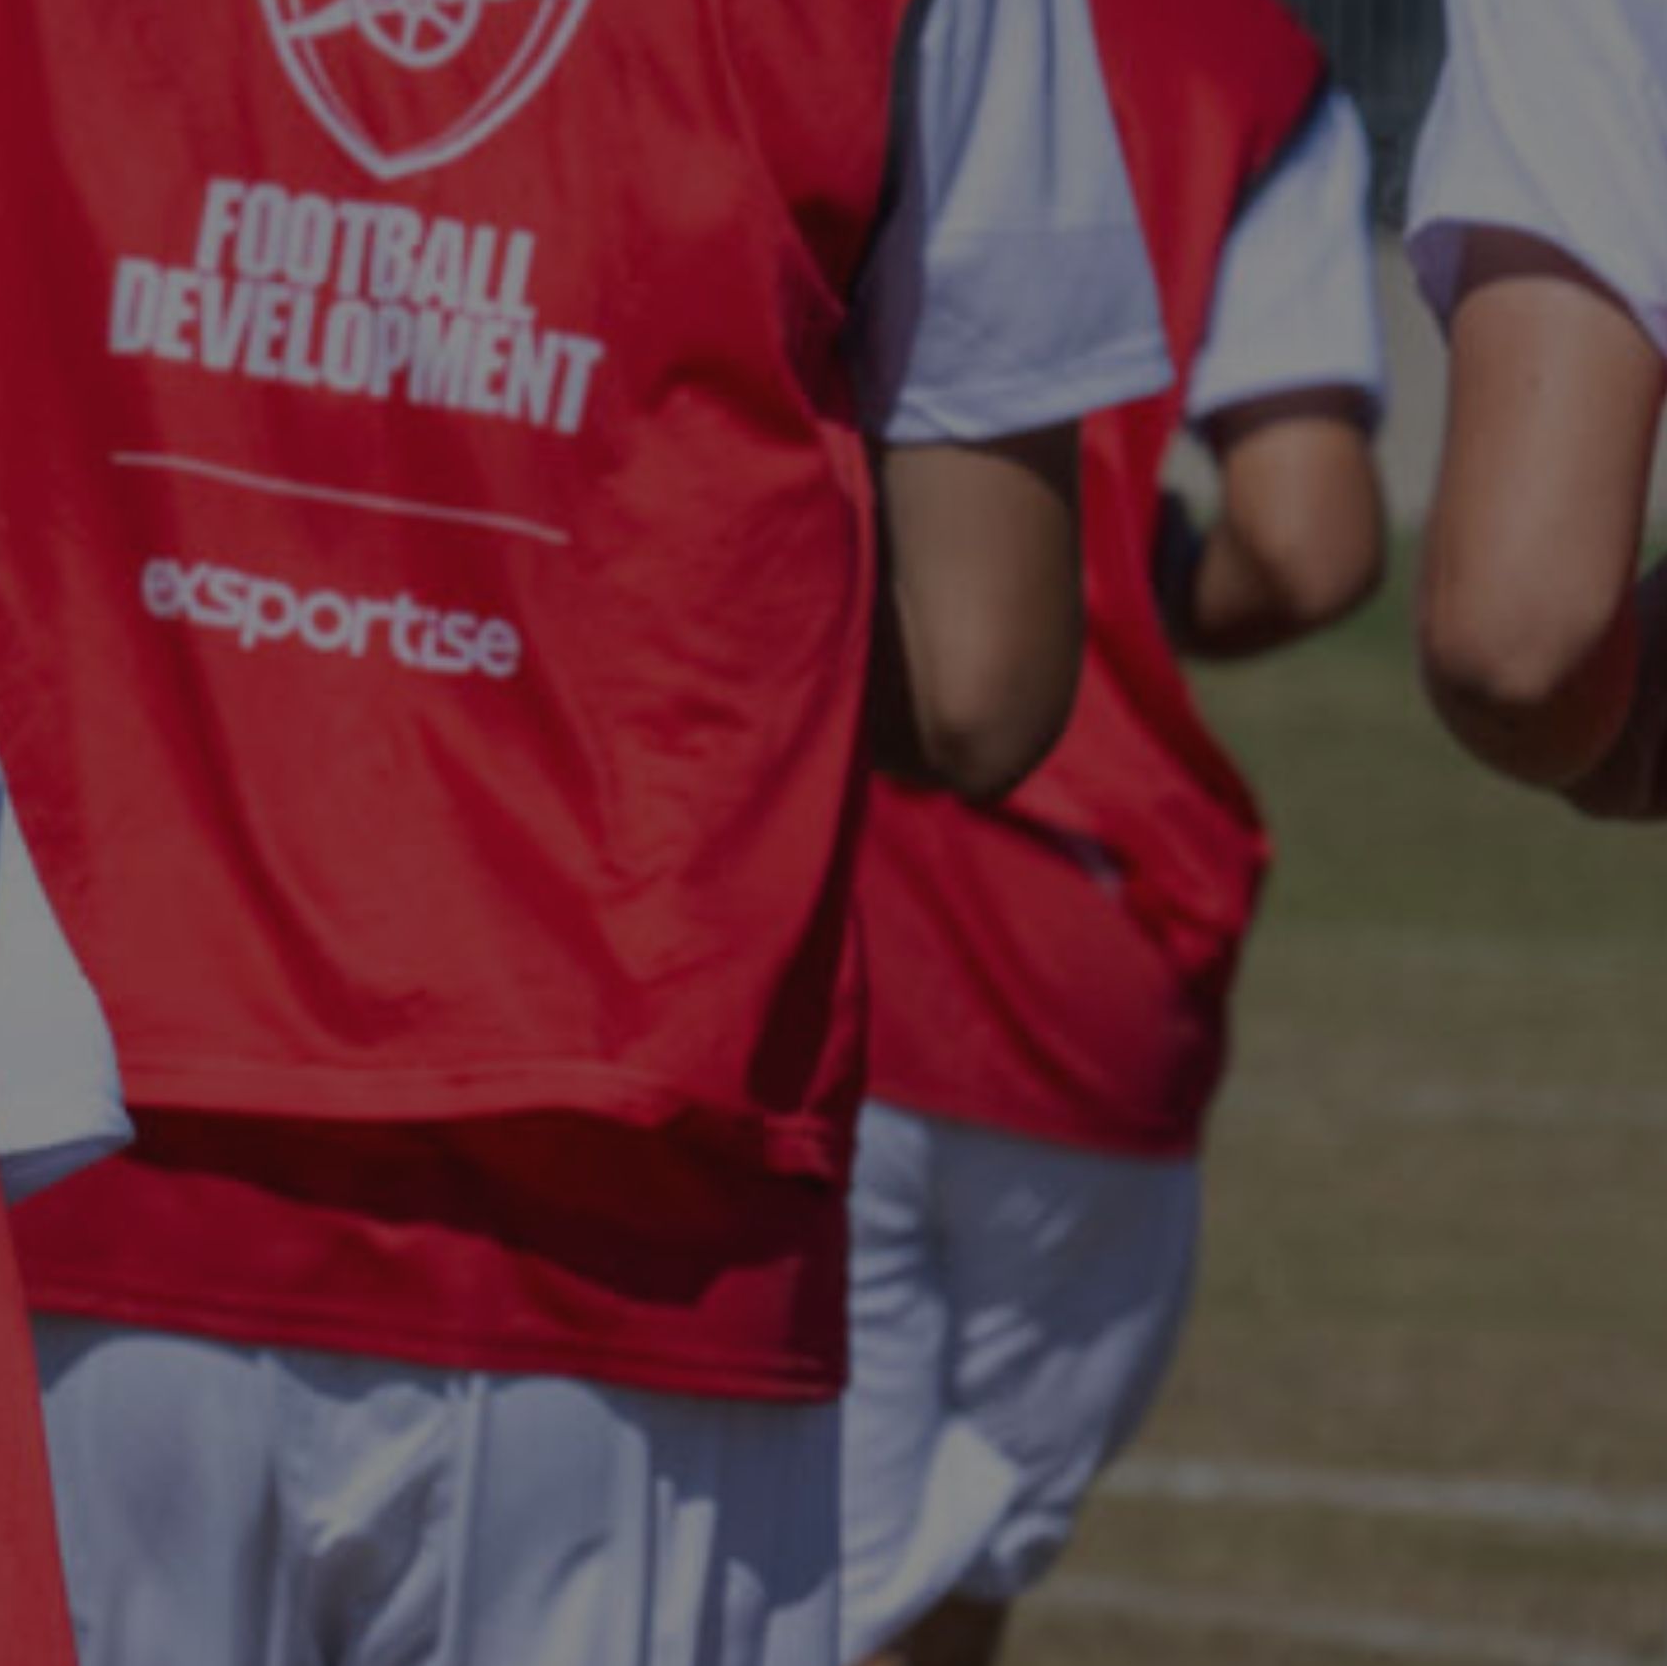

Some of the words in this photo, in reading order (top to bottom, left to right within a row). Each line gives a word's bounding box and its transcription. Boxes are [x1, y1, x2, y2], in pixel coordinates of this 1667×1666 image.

[195, 177, 535, 323] FOOTBALL
[108, 256, 605, 437] DEVELOPMENT
[142, 558, 521, 678] exsportise
